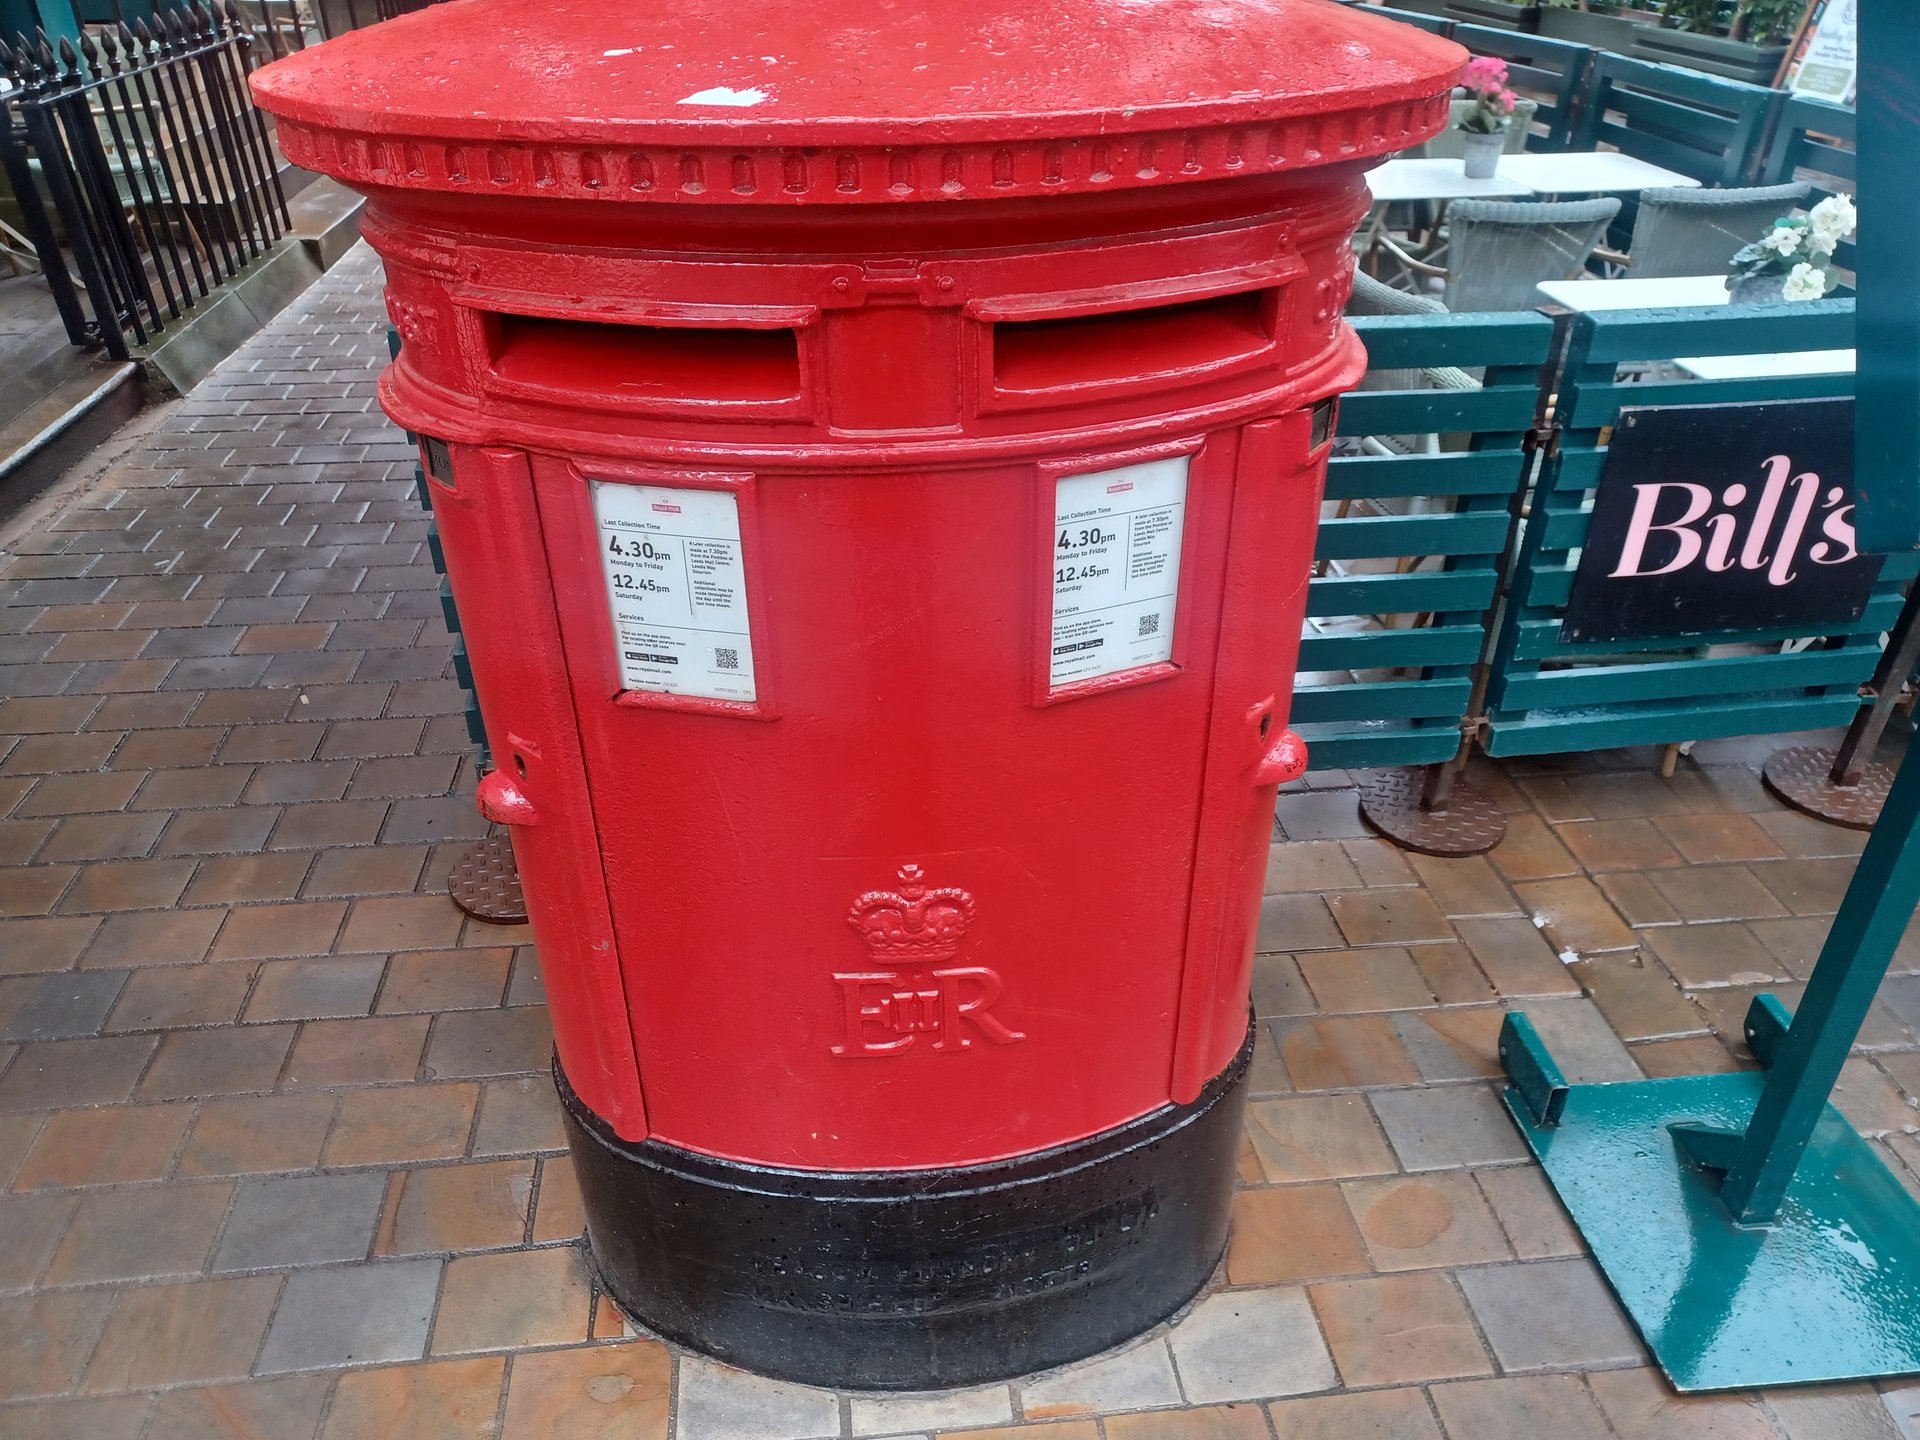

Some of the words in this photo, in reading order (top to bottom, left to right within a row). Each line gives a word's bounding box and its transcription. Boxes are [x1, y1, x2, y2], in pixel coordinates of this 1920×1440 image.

[1070, 510, 1097, 519] Collection
[1606, 454, 1858, 586] Bill's
[617, 520, 645, 528] Collection
[1057, 528, 1116, 550] 4.30pm
[609, 535, 671, 561] 4.30pm
[1056, 553, 1080, 561] Monday
[1089, 547, 1107, 555] Friday
[610, 559, 634, 568] Monday
[644, 562, 664, 571] Friday
[1056, 565, 1109, 584] 12.45pm
[613, 573, 670, 593] 12.45pm
[1055, 585, 1082, 594] Saturday
[615, 591, 643, 601] Saturday
[618, 612, 644, 621] Services
[1054, 606, 1079, 615] Services
[1052, 654, 1095, 666] www.royalmail.com
[627, 666, 672, 674] www.royalmail.com
